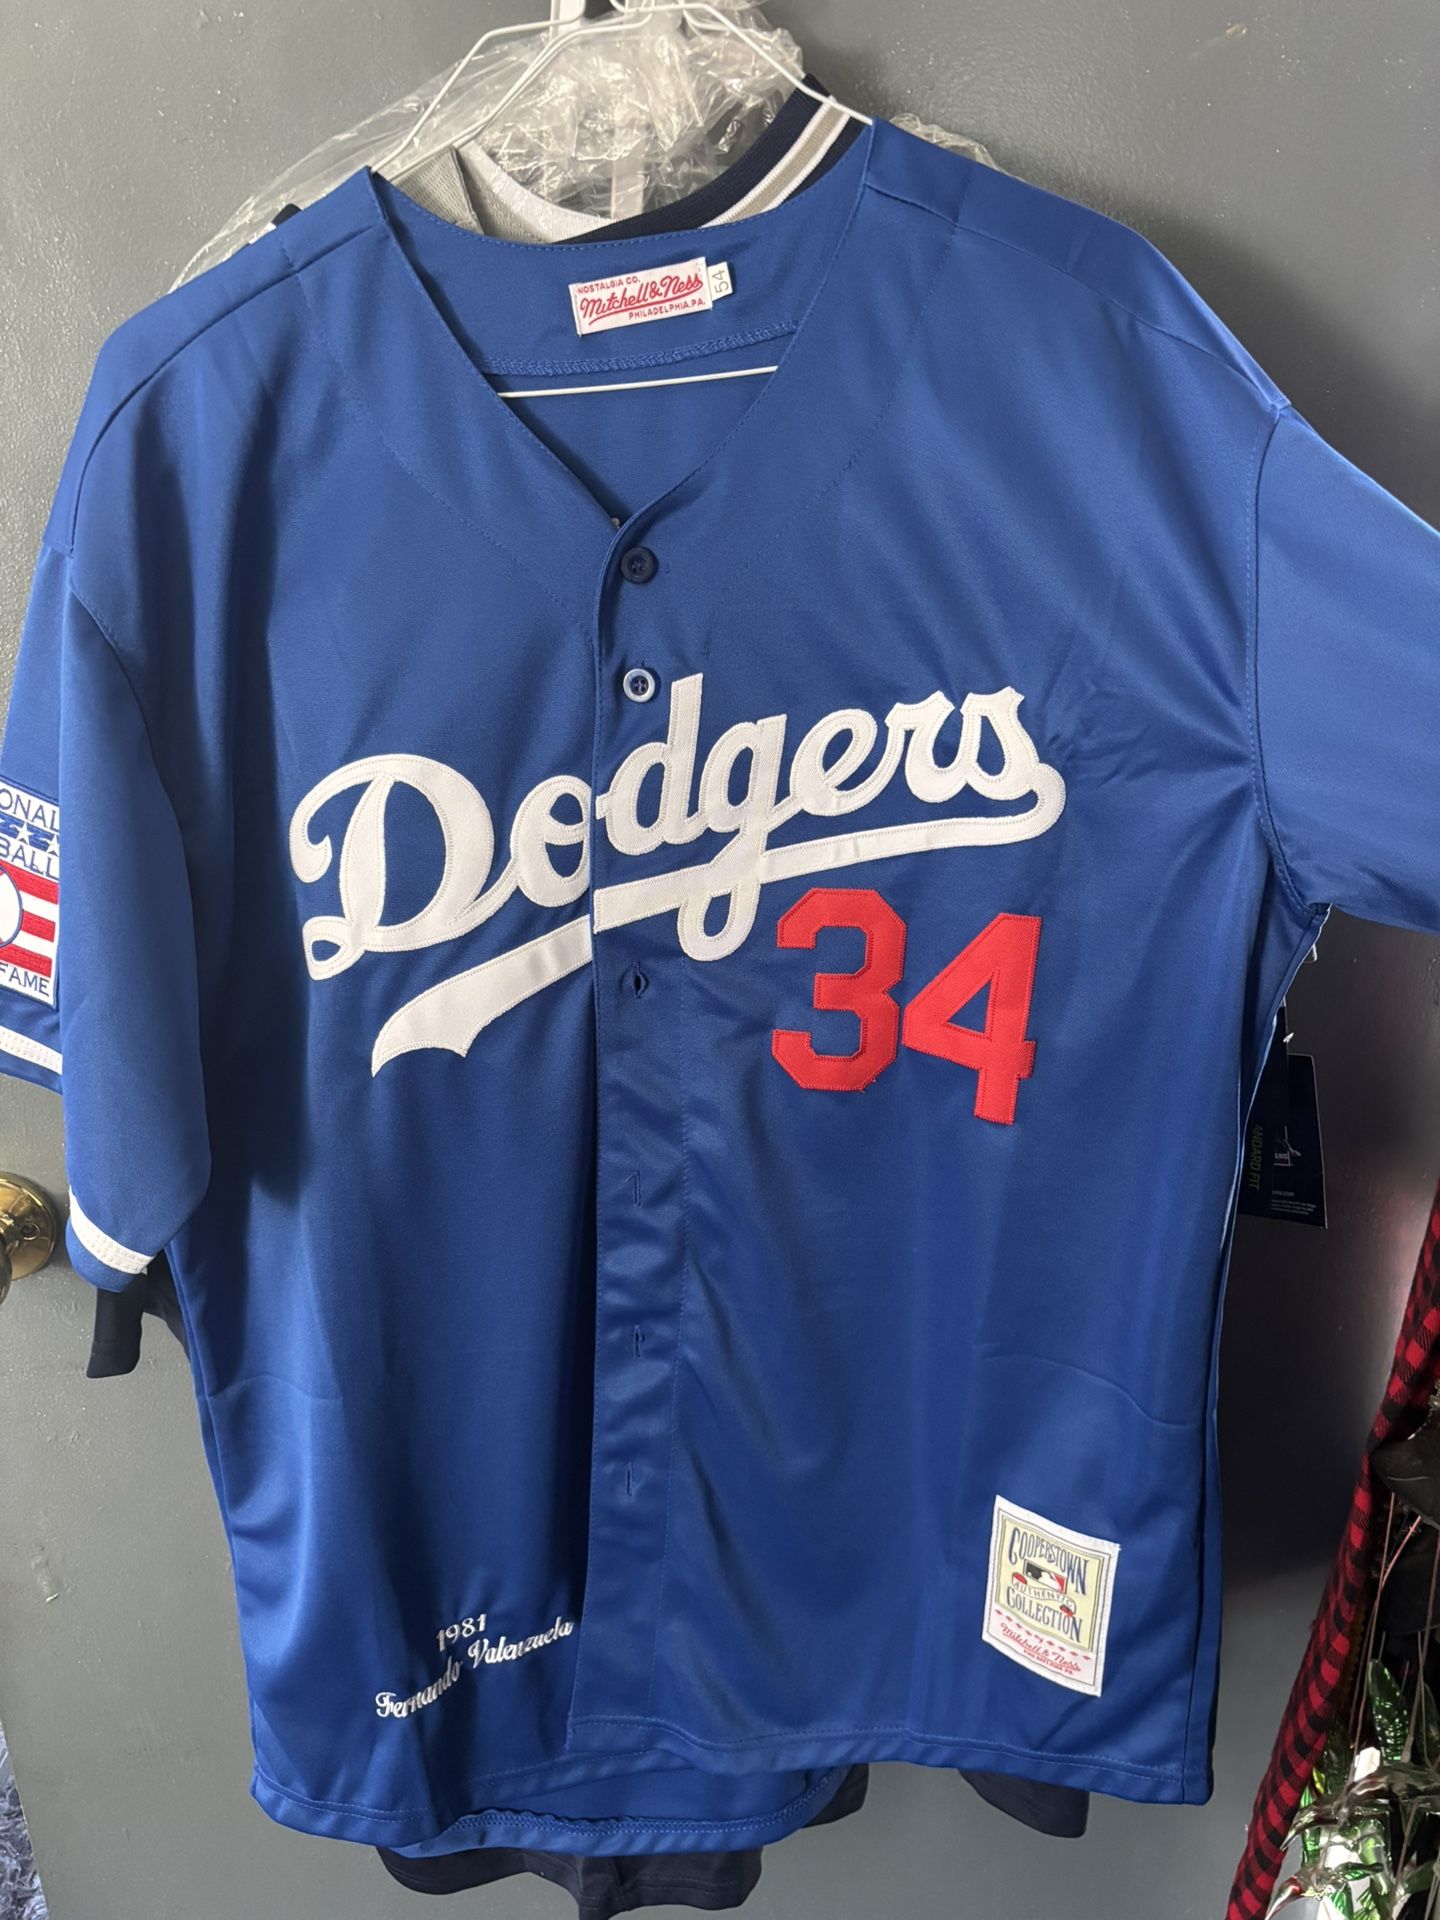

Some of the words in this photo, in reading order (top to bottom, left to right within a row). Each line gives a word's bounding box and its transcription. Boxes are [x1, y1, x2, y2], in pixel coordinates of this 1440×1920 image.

[577, 278, 624, 294] NOSTALGIA
[625, 275, 641, 285] CO.
[711, 269, 729, 293] 54
[290, 672, 1066, 982] Dodgers
[772, 888, 1043, 1126] 34
[1008, 1526, 1089, 1595] COOPERSTOWN
[436, 1613, 486, 1652] 1981
[1006, 1585, 1083, 1643] COLLECTION
[375, 1655, 463, 1718] Fernando
[467, 1616, 575, 1669] Valenzuela
